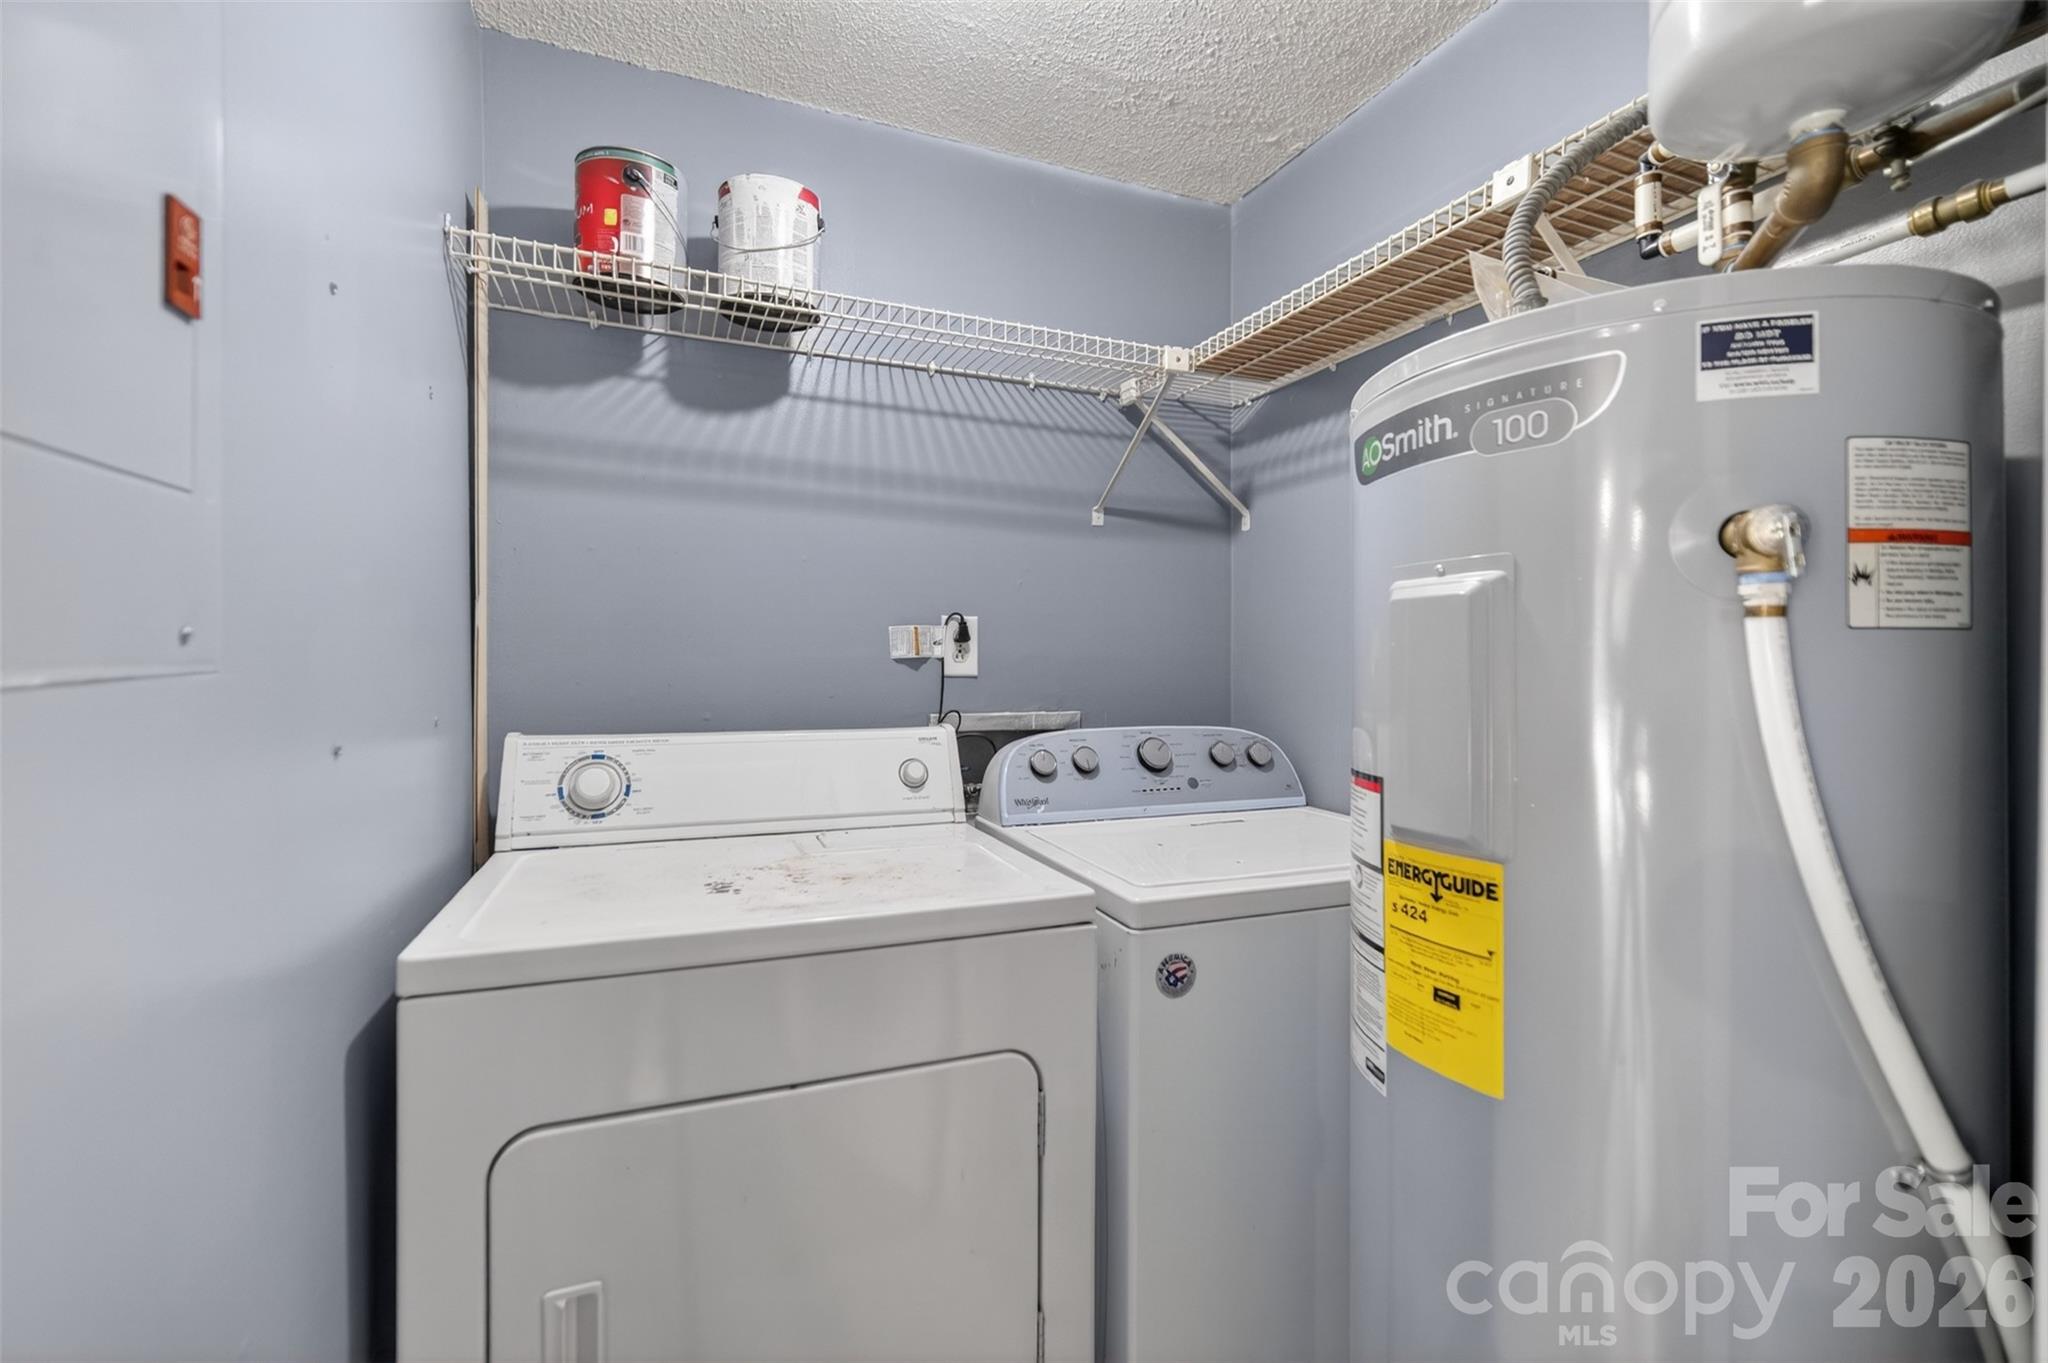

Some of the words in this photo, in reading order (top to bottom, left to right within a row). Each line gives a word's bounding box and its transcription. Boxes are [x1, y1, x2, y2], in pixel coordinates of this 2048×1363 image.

[1464, 377, 1583, 414] SIGNATURE
[1492, 410, 1549, 446] 100
[1388, 857, 1499, 902] ENERGYGUIDE
